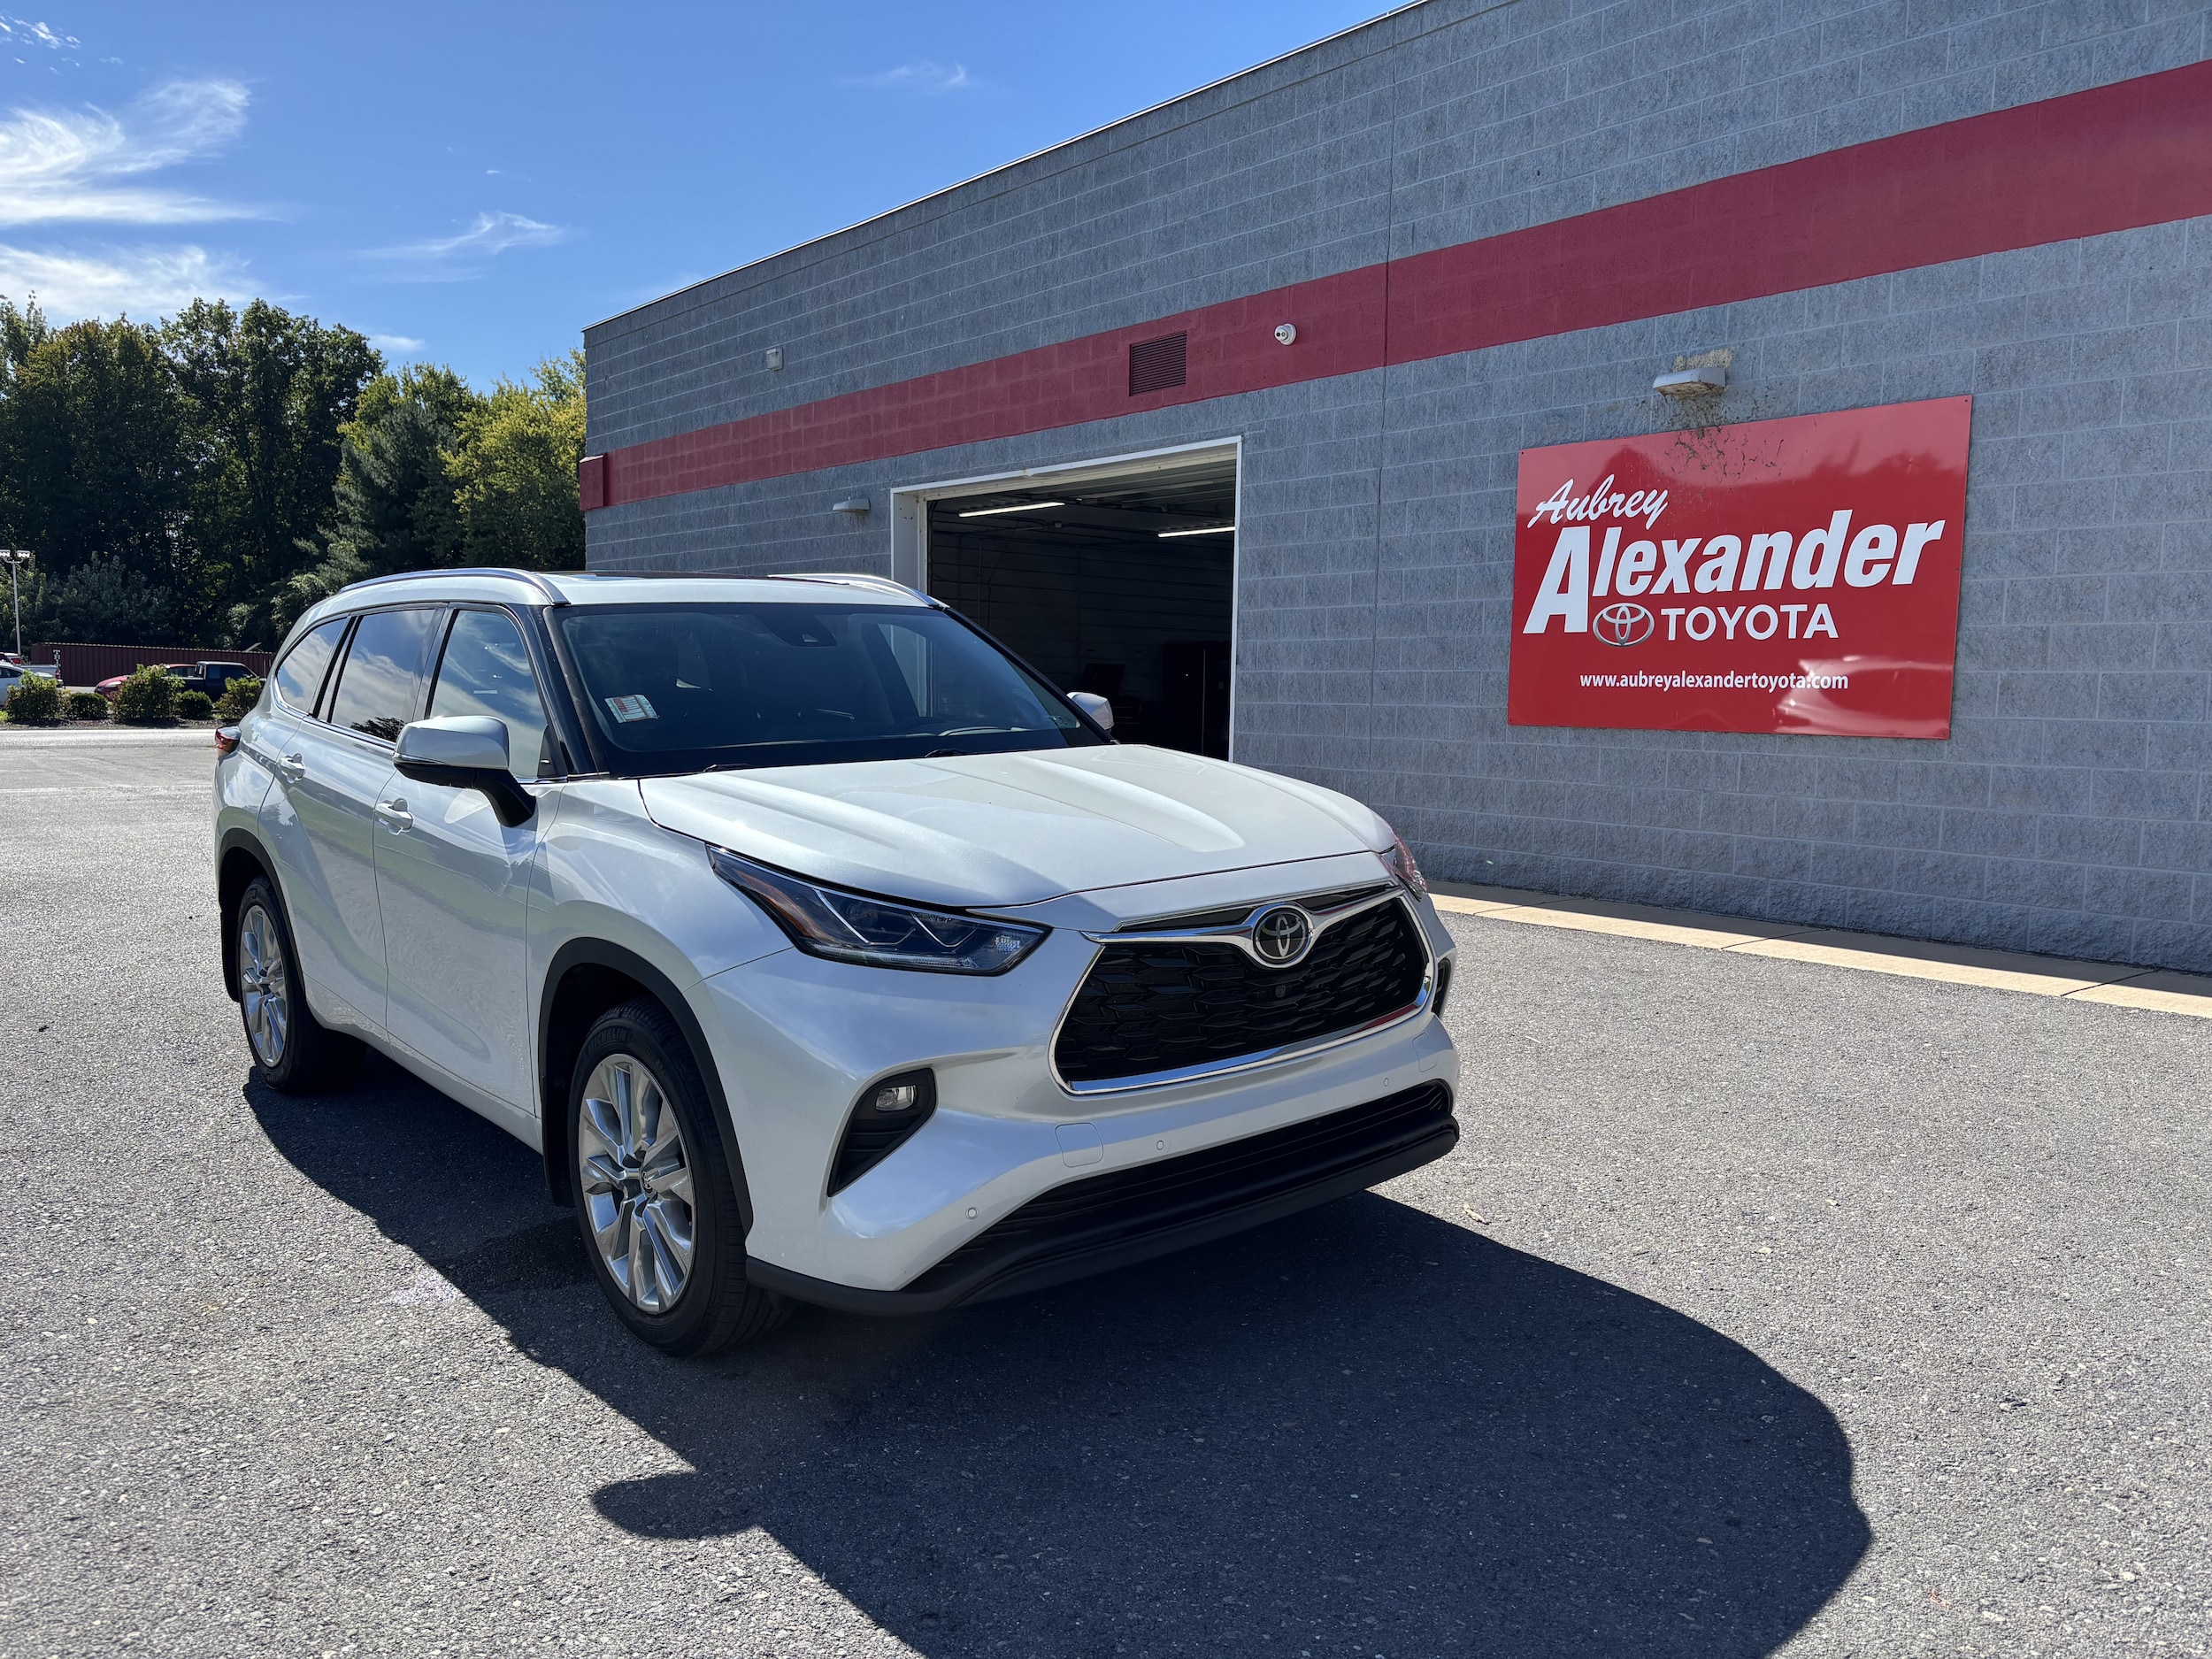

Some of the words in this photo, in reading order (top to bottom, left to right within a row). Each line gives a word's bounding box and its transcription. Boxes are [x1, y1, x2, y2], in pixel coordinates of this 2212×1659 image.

[1526, 473, 1669, 530] Aubrey
[1522, 509, 1946, 634] Alexander
[1660, 603, 1839, 641] TOYOTA
[1578, 670, 1849, 694] www.aubreyalexandertoyota.com
